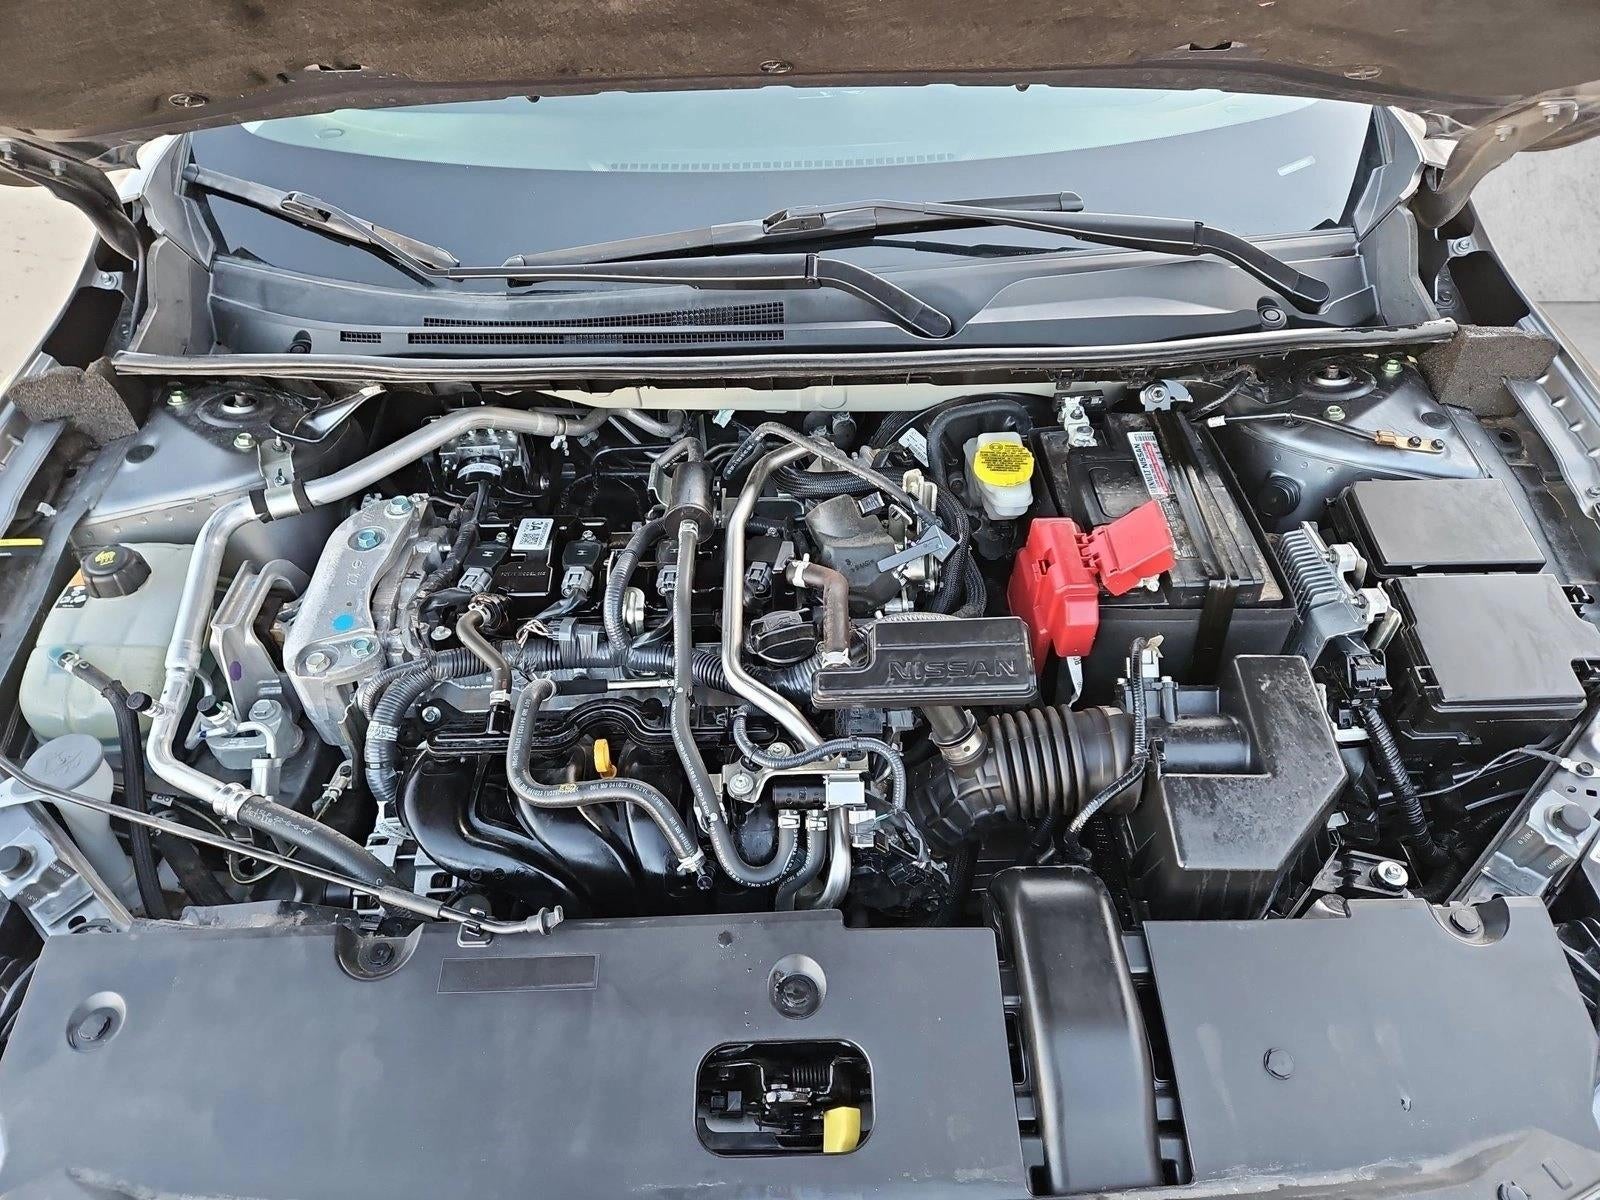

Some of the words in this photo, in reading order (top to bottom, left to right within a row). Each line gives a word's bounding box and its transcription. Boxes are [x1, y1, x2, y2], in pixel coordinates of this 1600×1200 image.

[1133, 443, 1149, 469] NISSAN
[529, 521, 544, 531] 3A
[888, 657, 1019, 680] NISSAN
